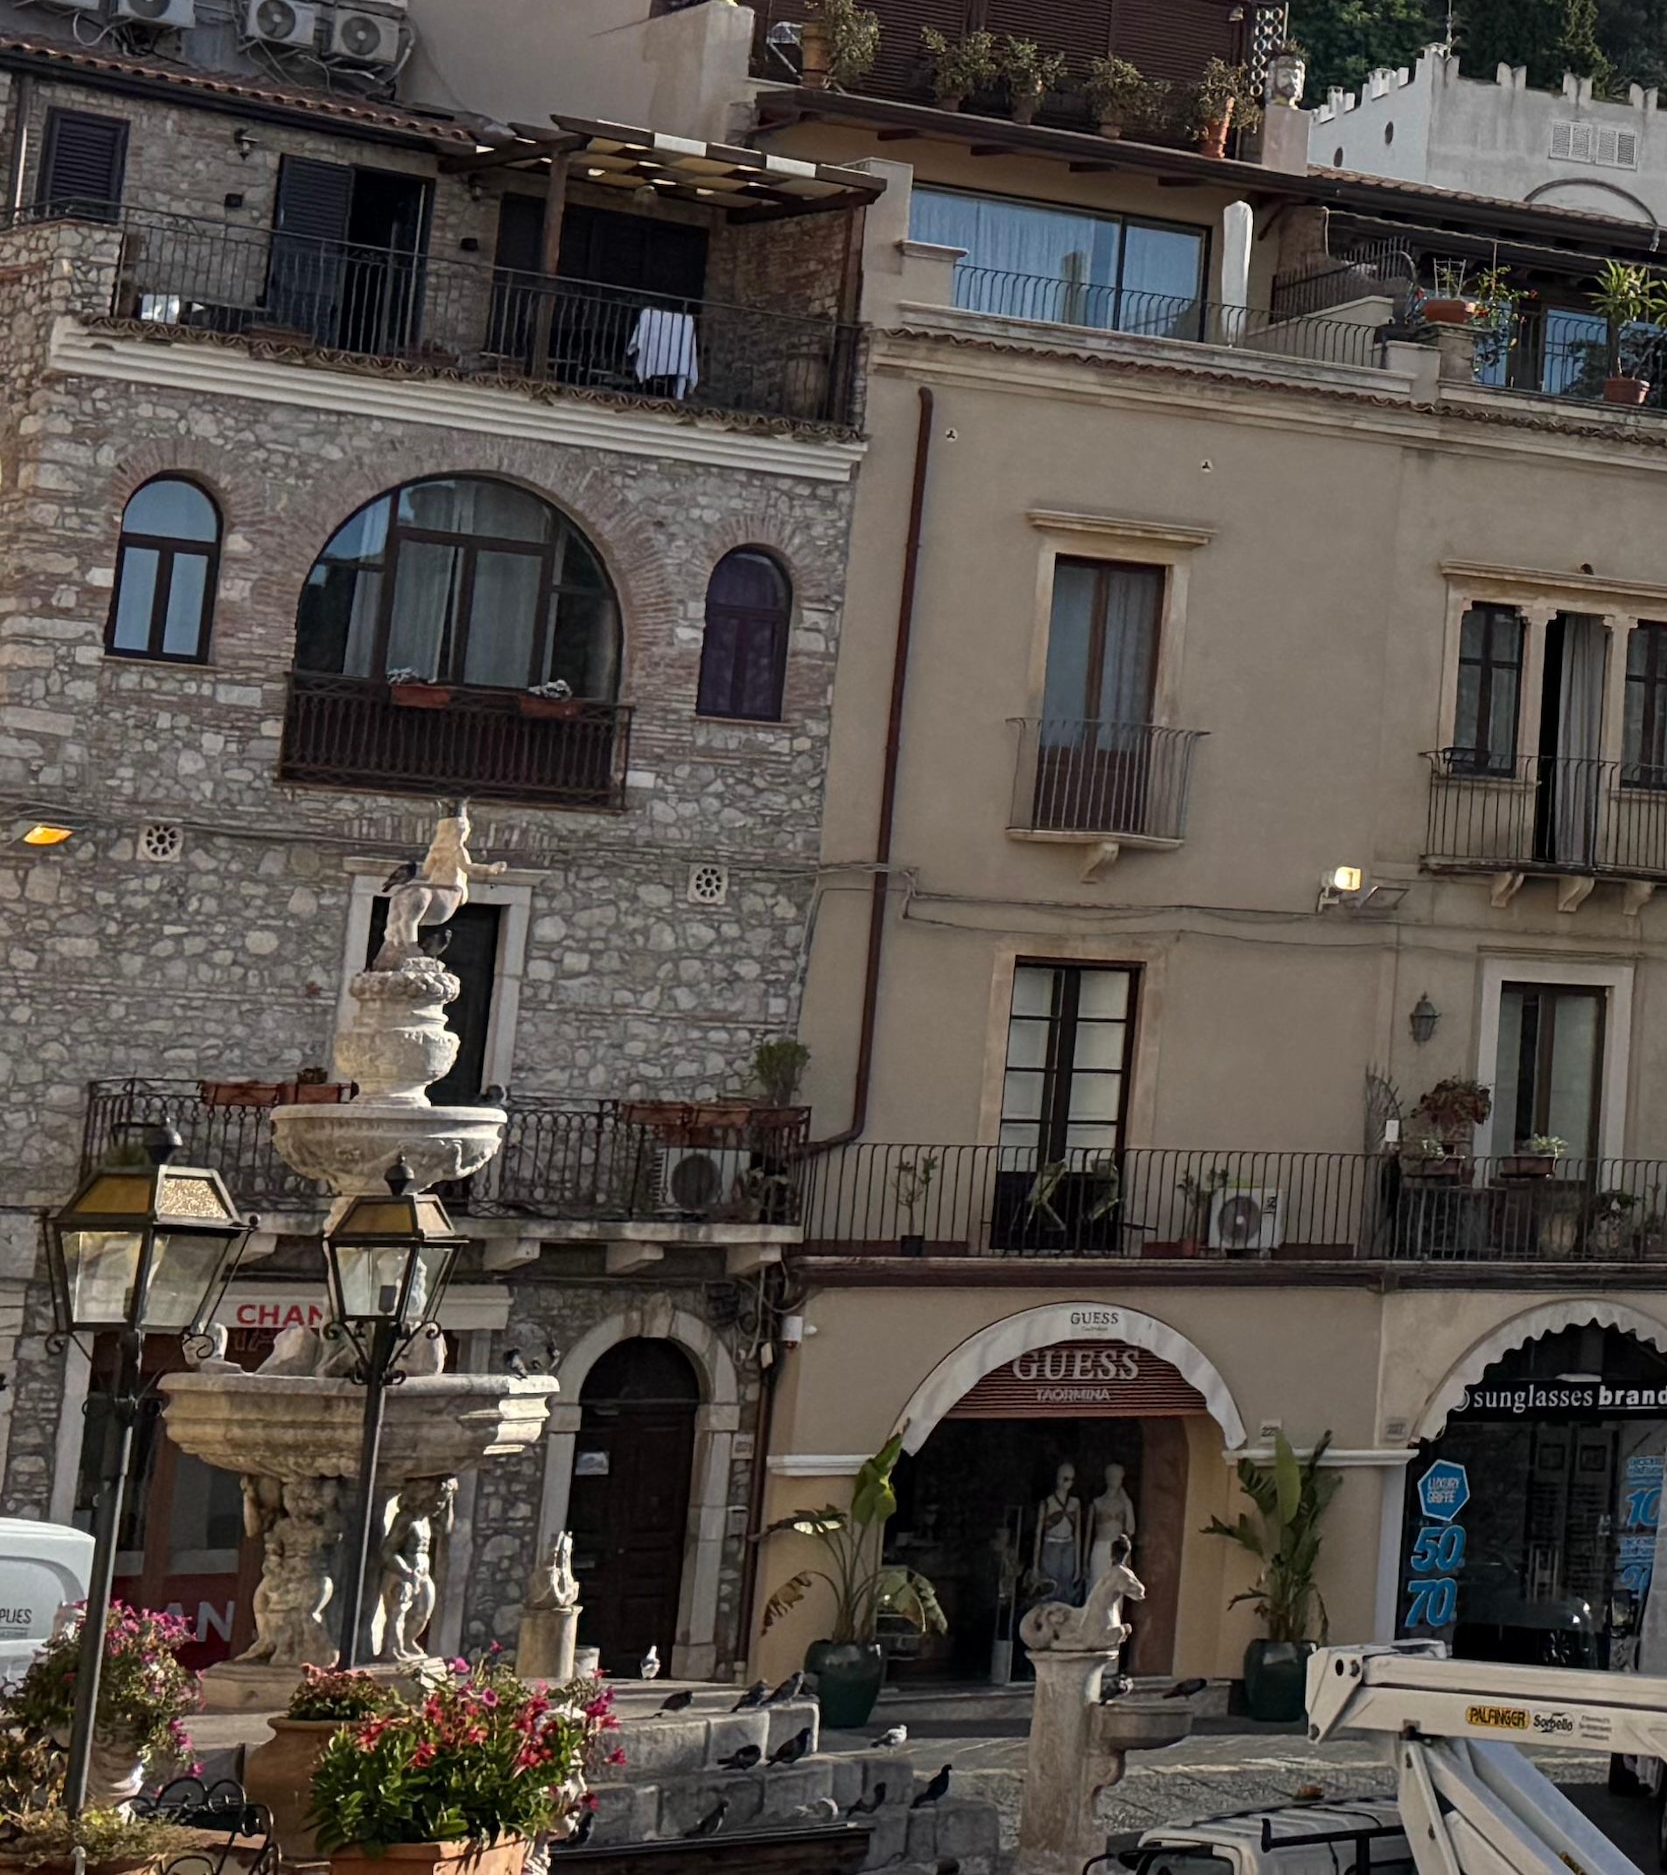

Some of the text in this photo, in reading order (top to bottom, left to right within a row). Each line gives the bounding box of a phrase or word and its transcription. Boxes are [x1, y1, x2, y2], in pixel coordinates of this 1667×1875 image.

[1070, 1311, 1120, 1325] GUESS
[1012, 1349, 1139, 1381] GUESS
[1036, 1388, 1111, 1402] TAORMINA
[1473, 1384, 1593, 1413] sunglasses
[1469, 1707, 1526, 1728] PALFINGER
